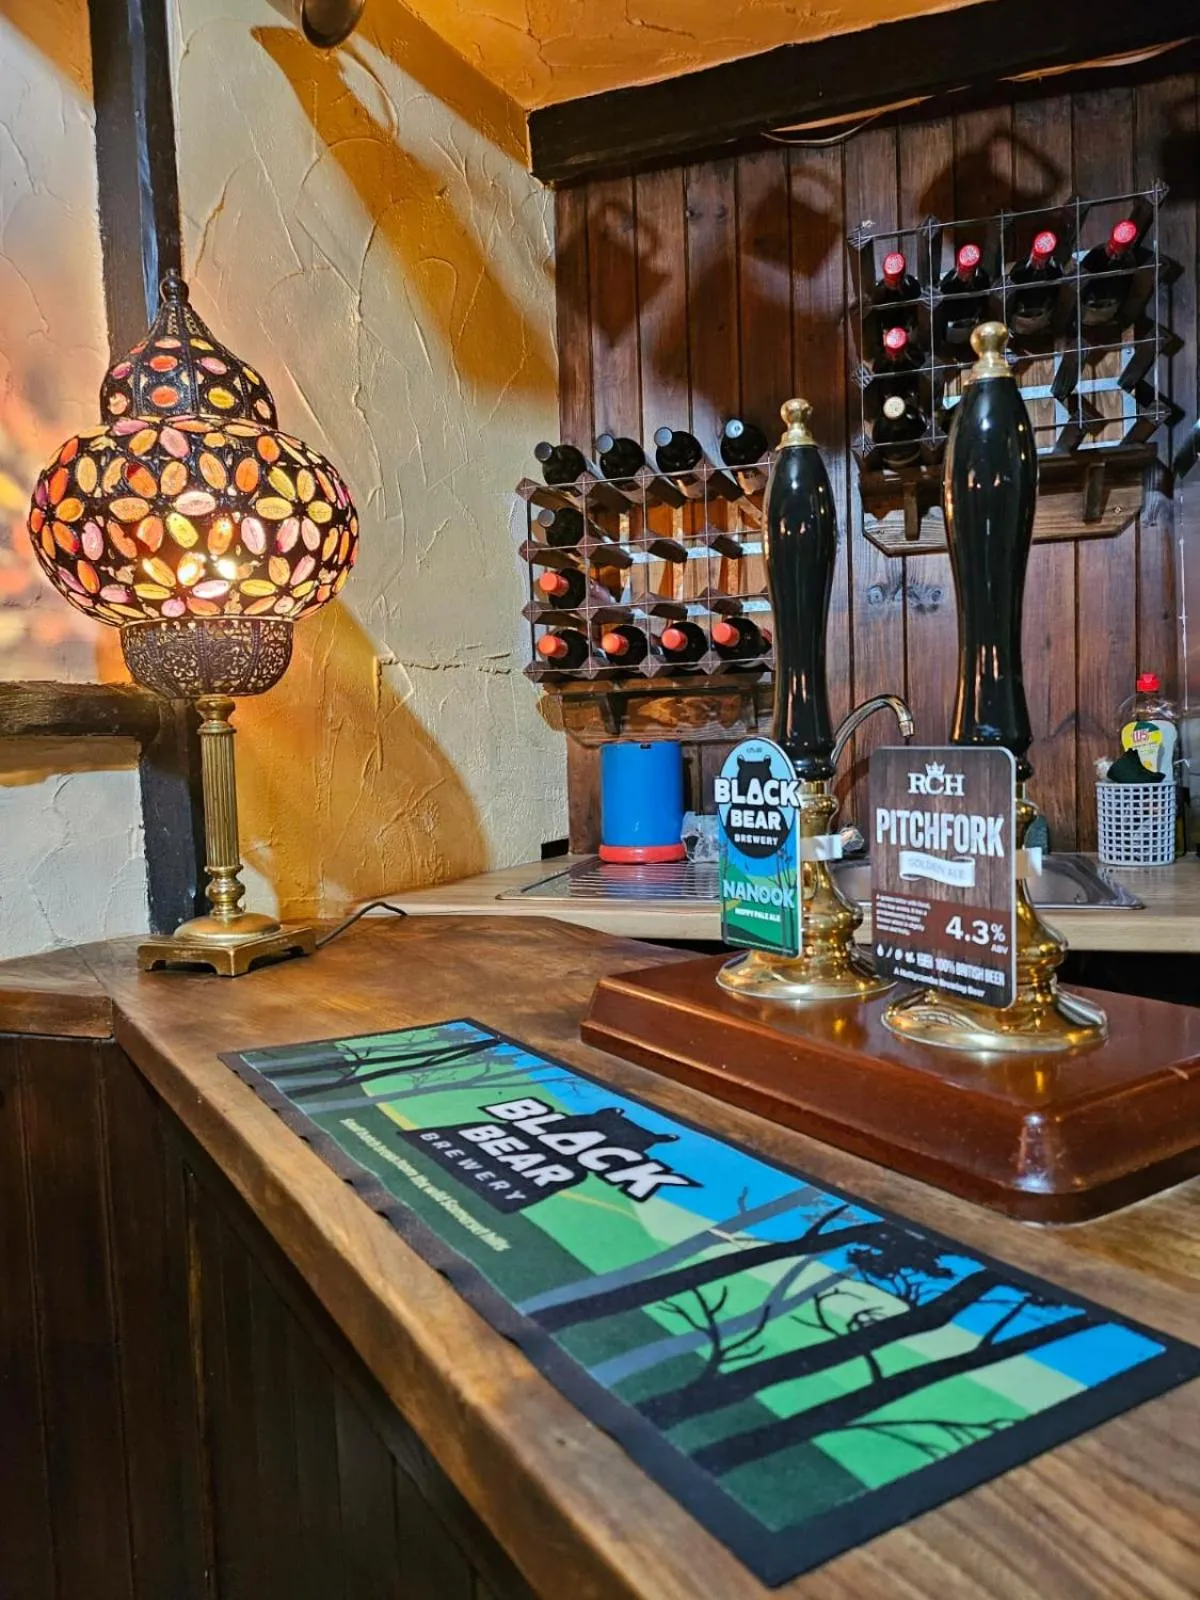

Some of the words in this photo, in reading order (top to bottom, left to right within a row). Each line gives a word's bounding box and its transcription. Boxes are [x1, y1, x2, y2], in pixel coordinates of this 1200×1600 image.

[714, 779, 800, 807] BLACK
[907, 772, 965, 796] RCH
[730, 809, 781, 831] BEAR
[876, 808, 1005, 858] PITCHFORK
[734, 834, 779, 846] BREWERY
[722, 880, 794, 909] NANOOK
[945, 915, 1006, 945] 4.3%
[458, 1124, 575, 1186] BEAR
[485, 1098, 690, 1199] BLACK
[420, 1132, 527, 1201] BREWERY
